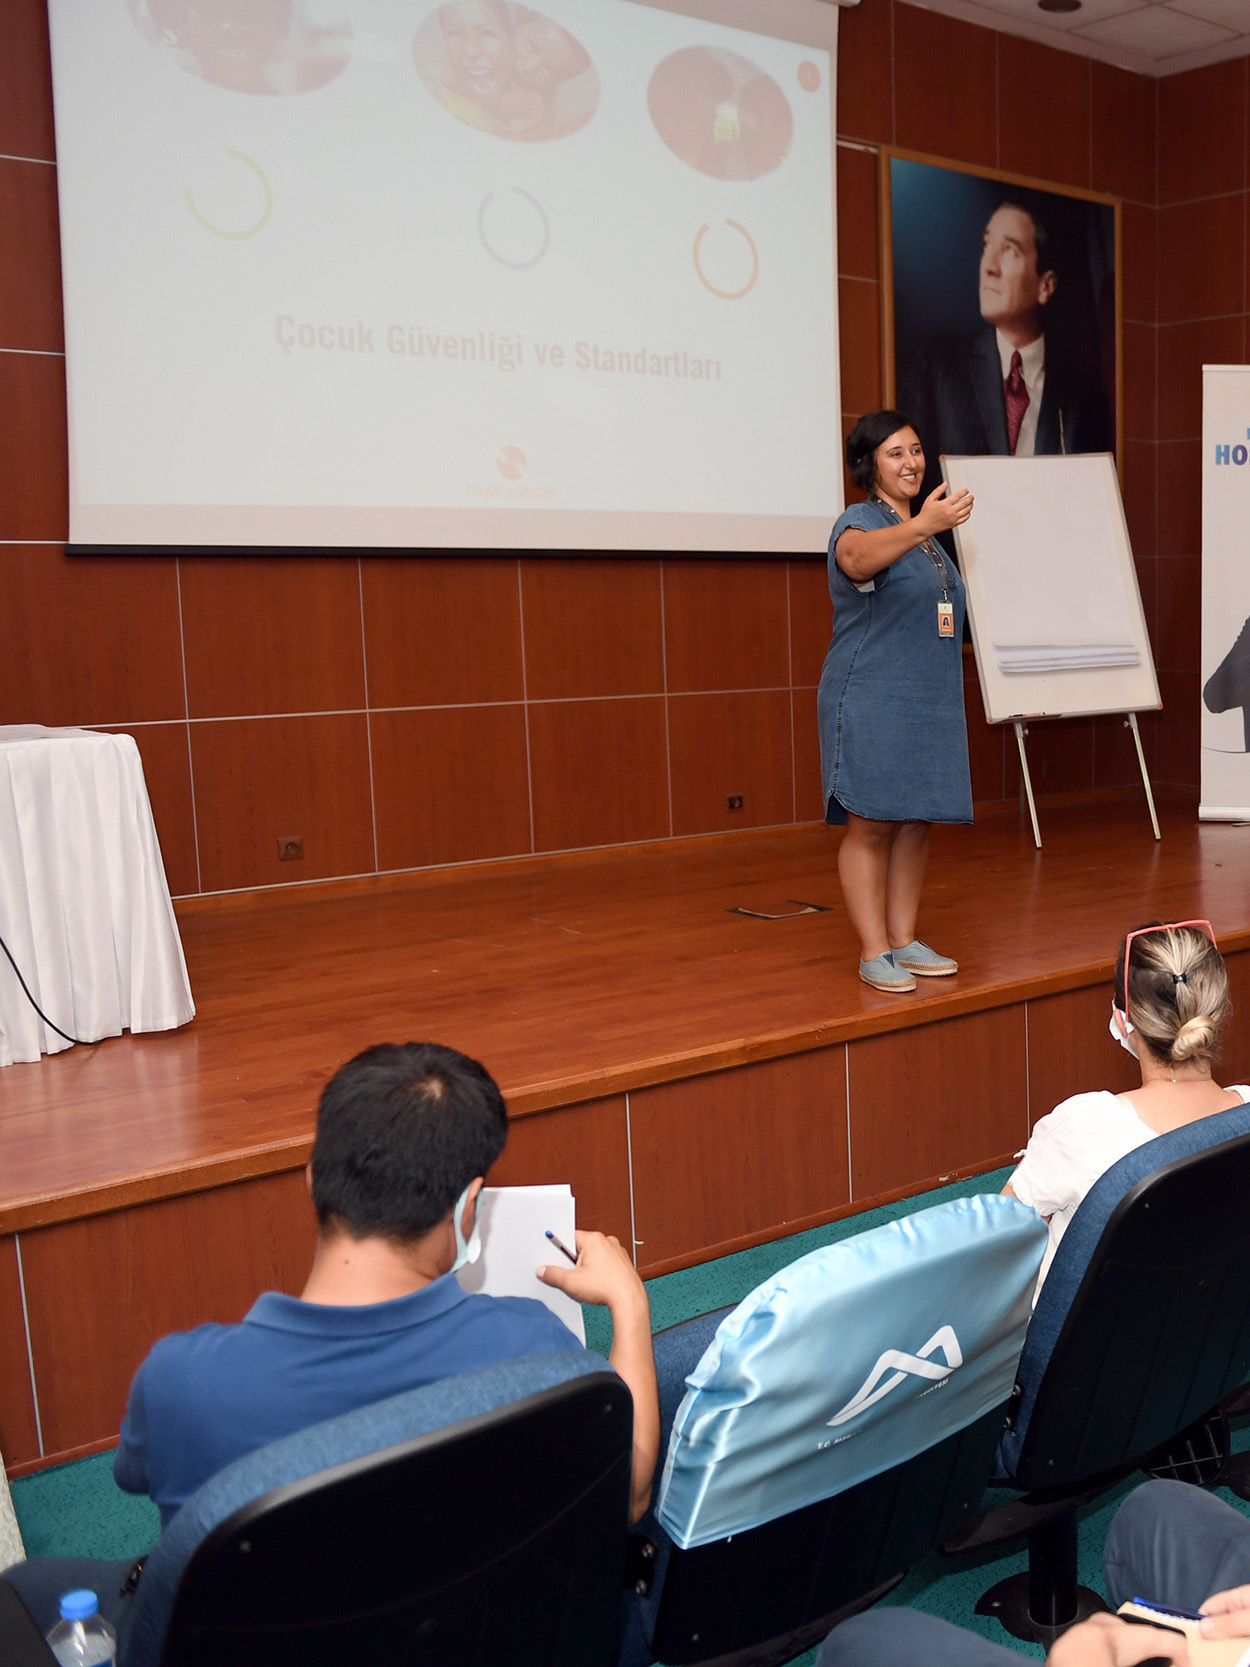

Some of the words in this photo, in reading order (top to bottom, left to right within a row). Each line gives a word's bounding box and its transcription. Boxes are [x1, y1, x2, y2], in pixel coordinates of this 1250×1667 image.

[275, 314, 375, 357] Çocuk
[386, 323, 523, 372] Güvenliği
[533, 342, 566, 368] ve
[575, 340, 722, 381] Standartları
